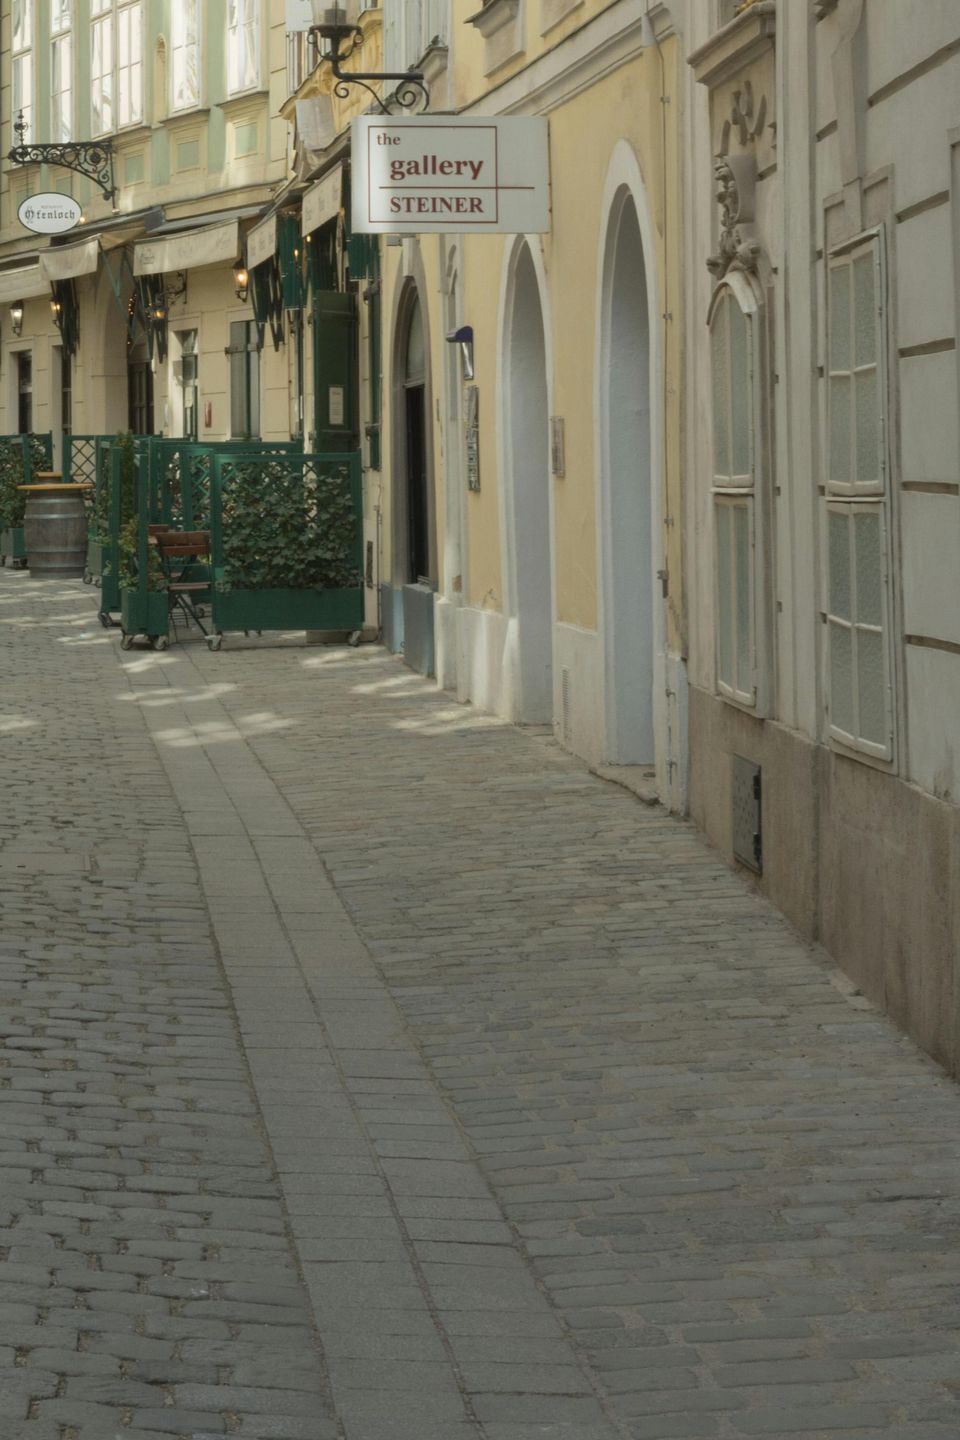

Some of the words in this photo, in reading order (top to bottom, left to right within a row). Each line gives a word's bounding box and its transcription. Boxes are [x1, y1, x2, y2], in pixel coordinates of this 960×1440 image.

[377, 133, 400, 145] the
[390, 155, 484, 180] gallery
[390, 196, 484, 213] STEINER
